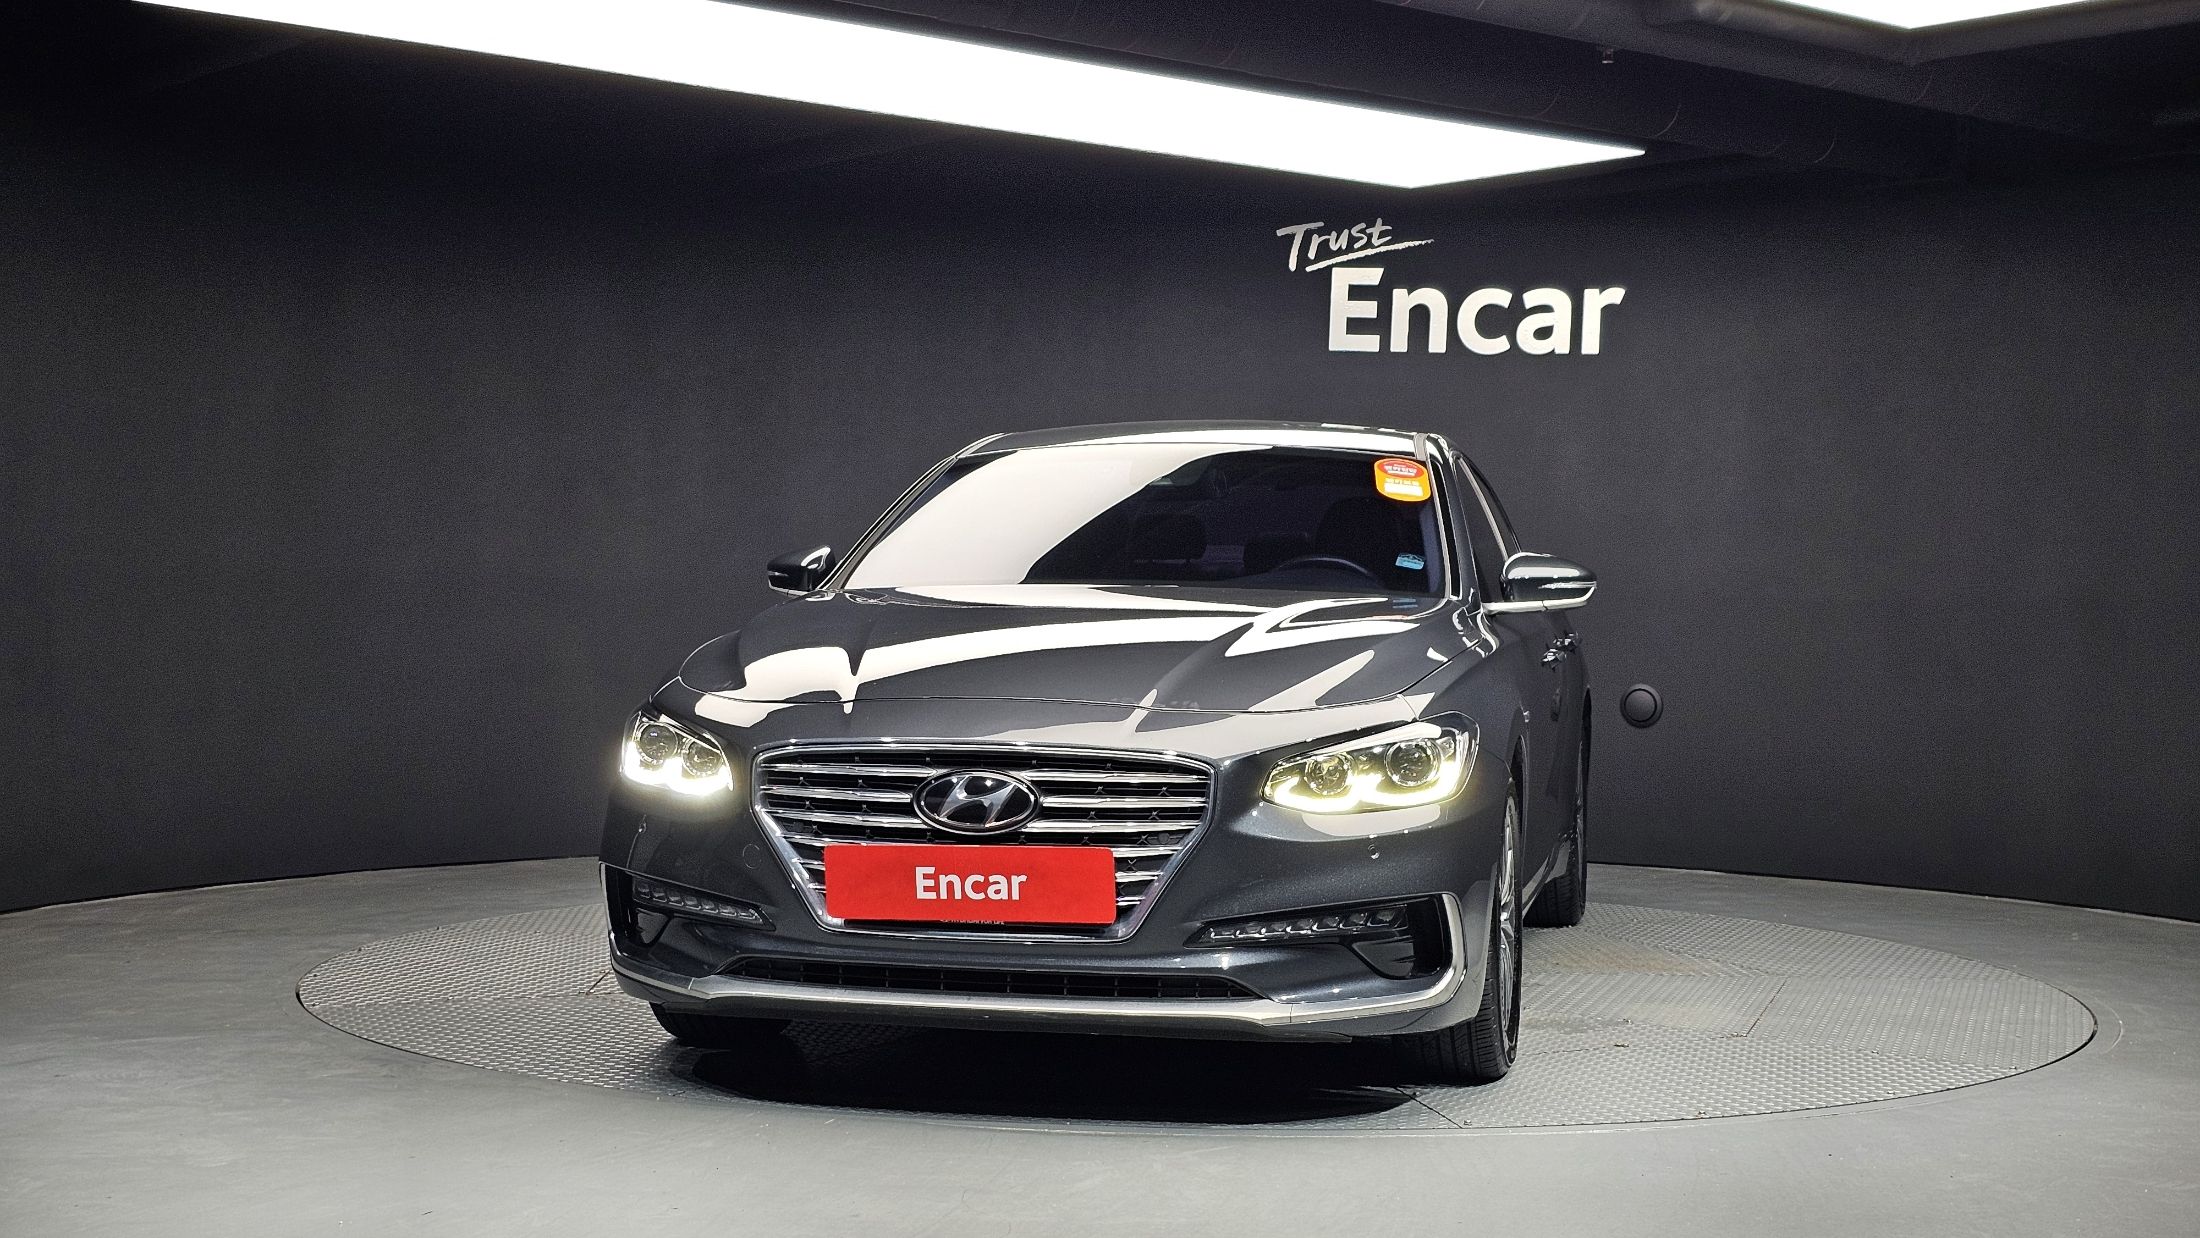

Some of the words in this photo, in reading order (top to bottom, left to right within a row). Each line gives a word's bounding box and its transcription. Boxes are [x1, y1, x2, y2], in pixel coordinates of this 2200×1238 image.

[1276, 218, 1392, 271] Trust
[1328, 267, 1626, 355] Encar
[915, 866, 1028, 900] Encar
